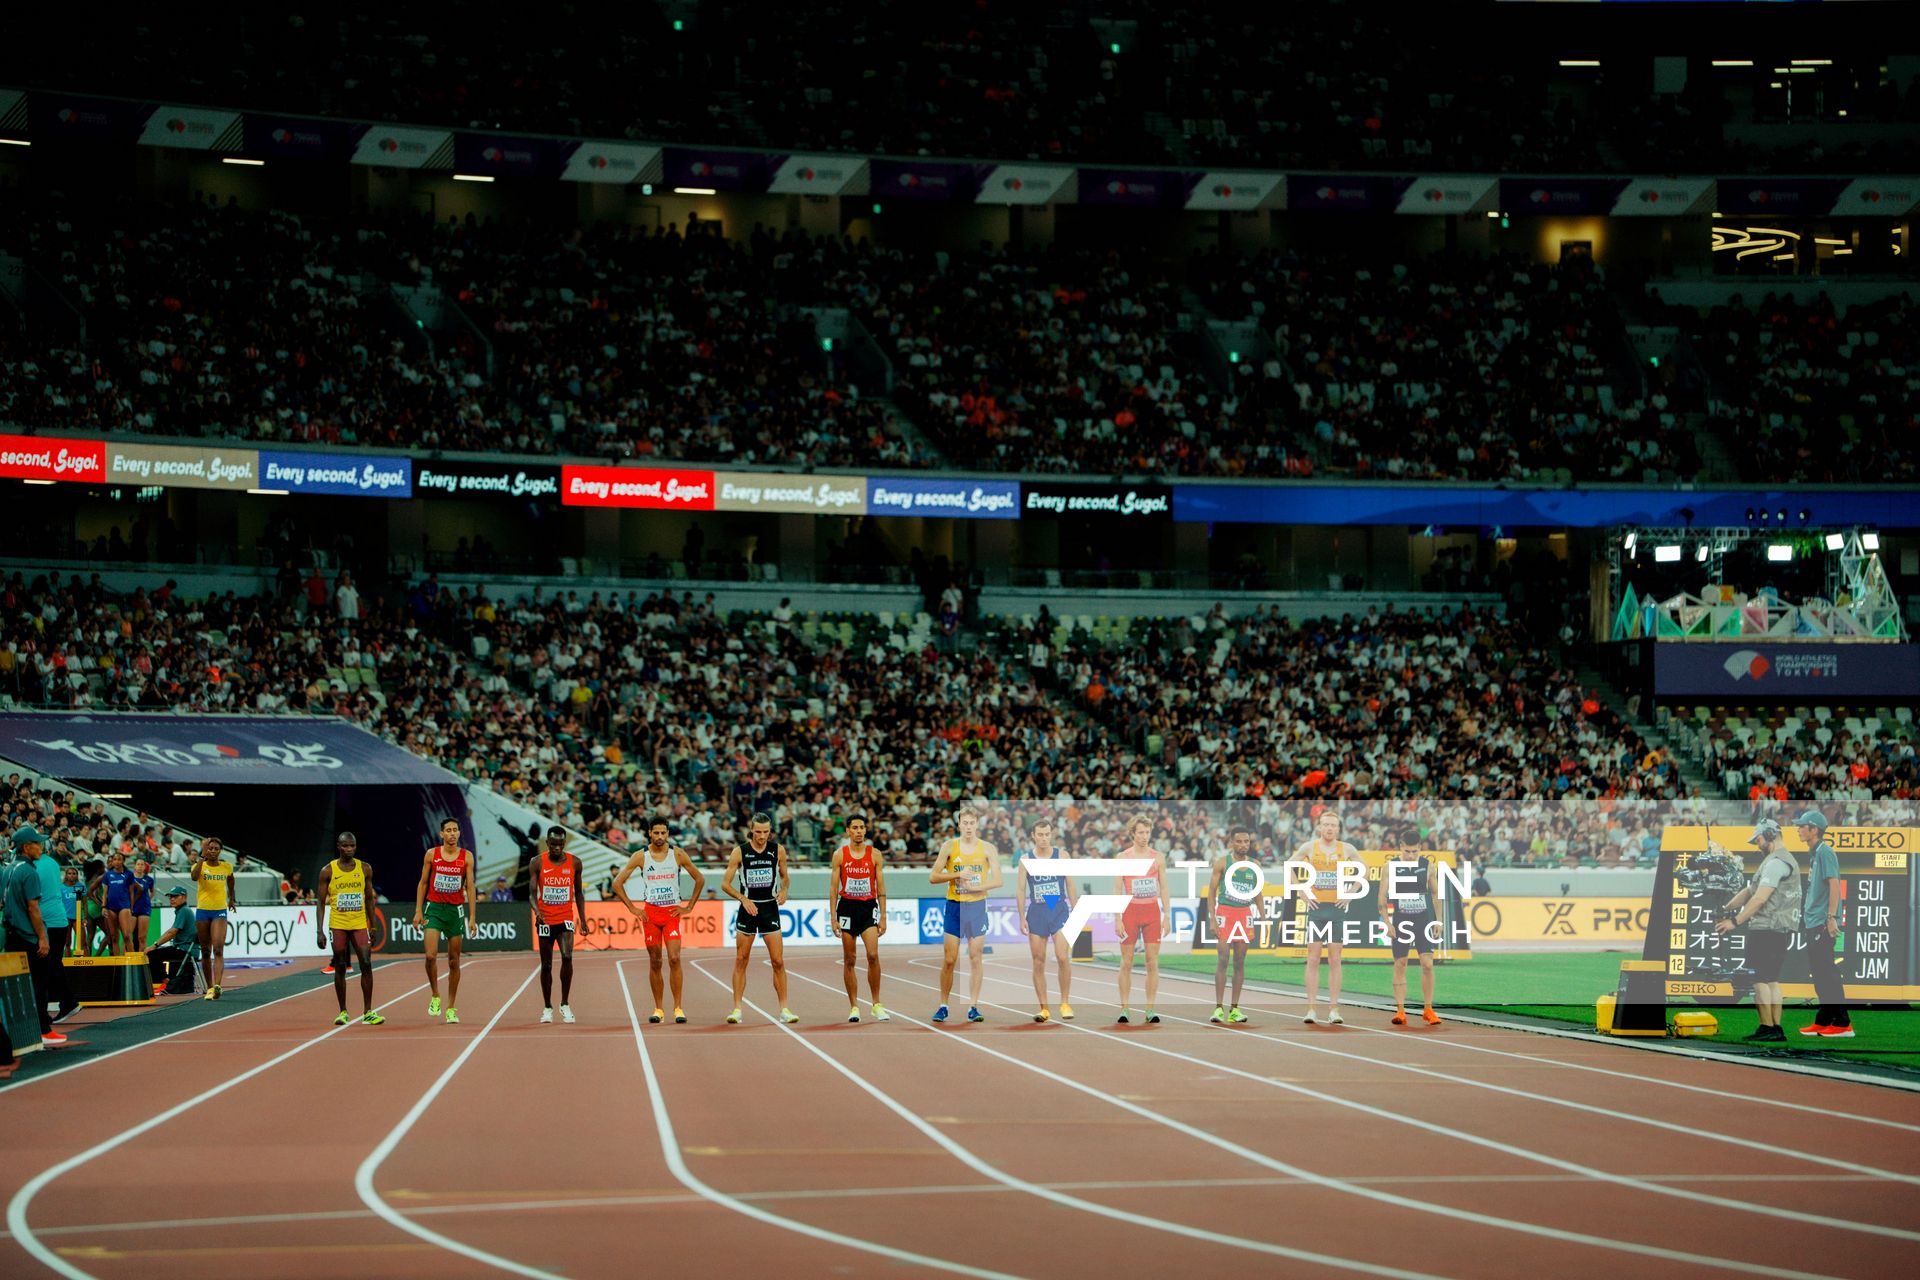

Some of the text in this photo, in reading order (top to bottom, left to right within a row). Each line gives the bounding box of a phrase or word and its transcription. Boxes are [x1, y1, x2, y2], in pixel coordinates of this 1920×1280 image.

[0, 449, 99, 472] second, Sugoi.
[113, 455, 252, 481] Every second, Sugoi.
[266, 463, 405, 489] Every second, Sugoi.
[419, 470, 557, 496] Every second, Sugoi.
[570, 478, 708, 501] Every second, Sugoi.
[722, 484, 861, 507] Every second, Sugoi.
[873, 487, 1014, 512] Every second, Sugoi.
[1027, 492, 1167, 514] Every second, Sugoi.
[1824, 832, 1905, 848] SEIKO
[953, 864, 983, 872] SWDEN
[544, 877, 571, 885] KENYA
[1858, 880, 1884, 901] SUI
[759, 908, 820, 938] DK
[842, 918, 848, 927] 7
[1673, 907, 1685, 920] 10
[1857, 905, 1890, 927] PUR
[225, 920, 295, 954] orpay
[391, 917, 449, 941] Pins
[540, 926, 549, 935] 10
[1672, 933, 1683, 945] 11
[1856, 931, 1890, 953] NGR
[1671, 959, 1683, 972] 12
[1855, 957, 1889, 979] JAM
[1670, 982, 1717, 993] SEIKO
